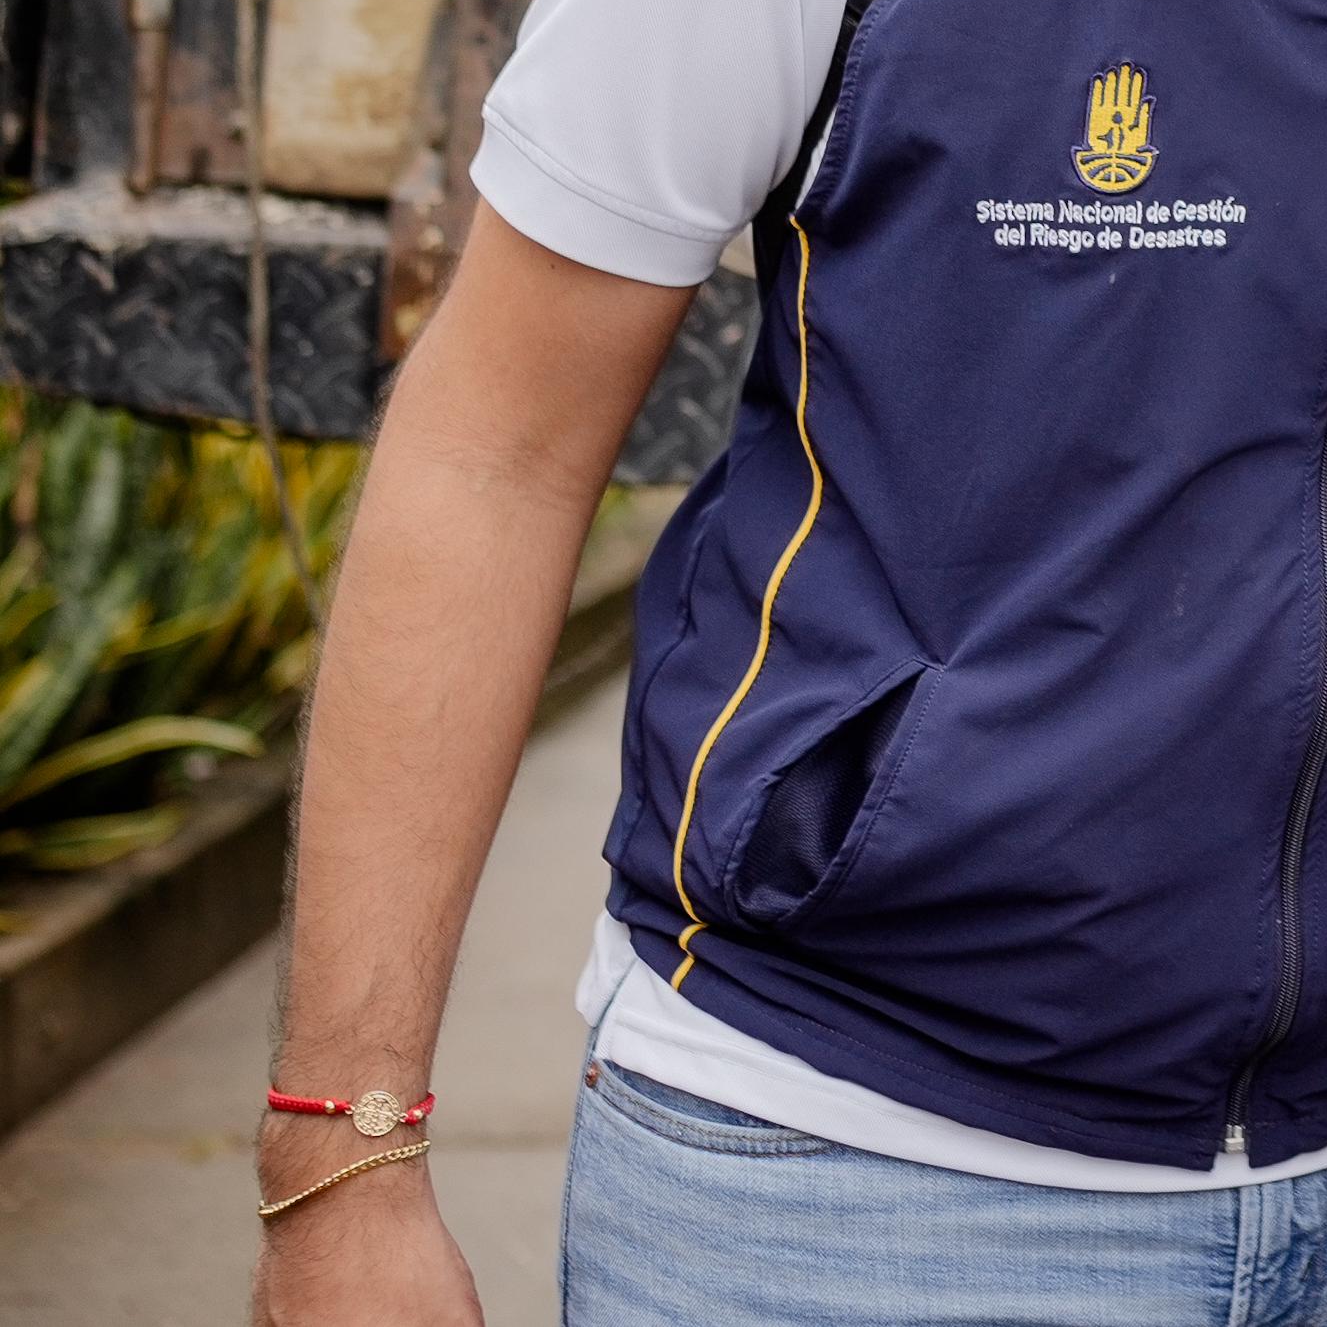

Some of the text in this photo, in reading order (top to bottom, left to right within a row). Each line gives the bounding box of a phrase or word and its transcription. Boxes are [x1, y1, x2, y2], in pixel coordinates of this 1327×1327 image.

[976, 195, 1247, 224] Sistema Nacional de Gestión
[994, 222, 1228, 254] del Riesgo de Desastres
